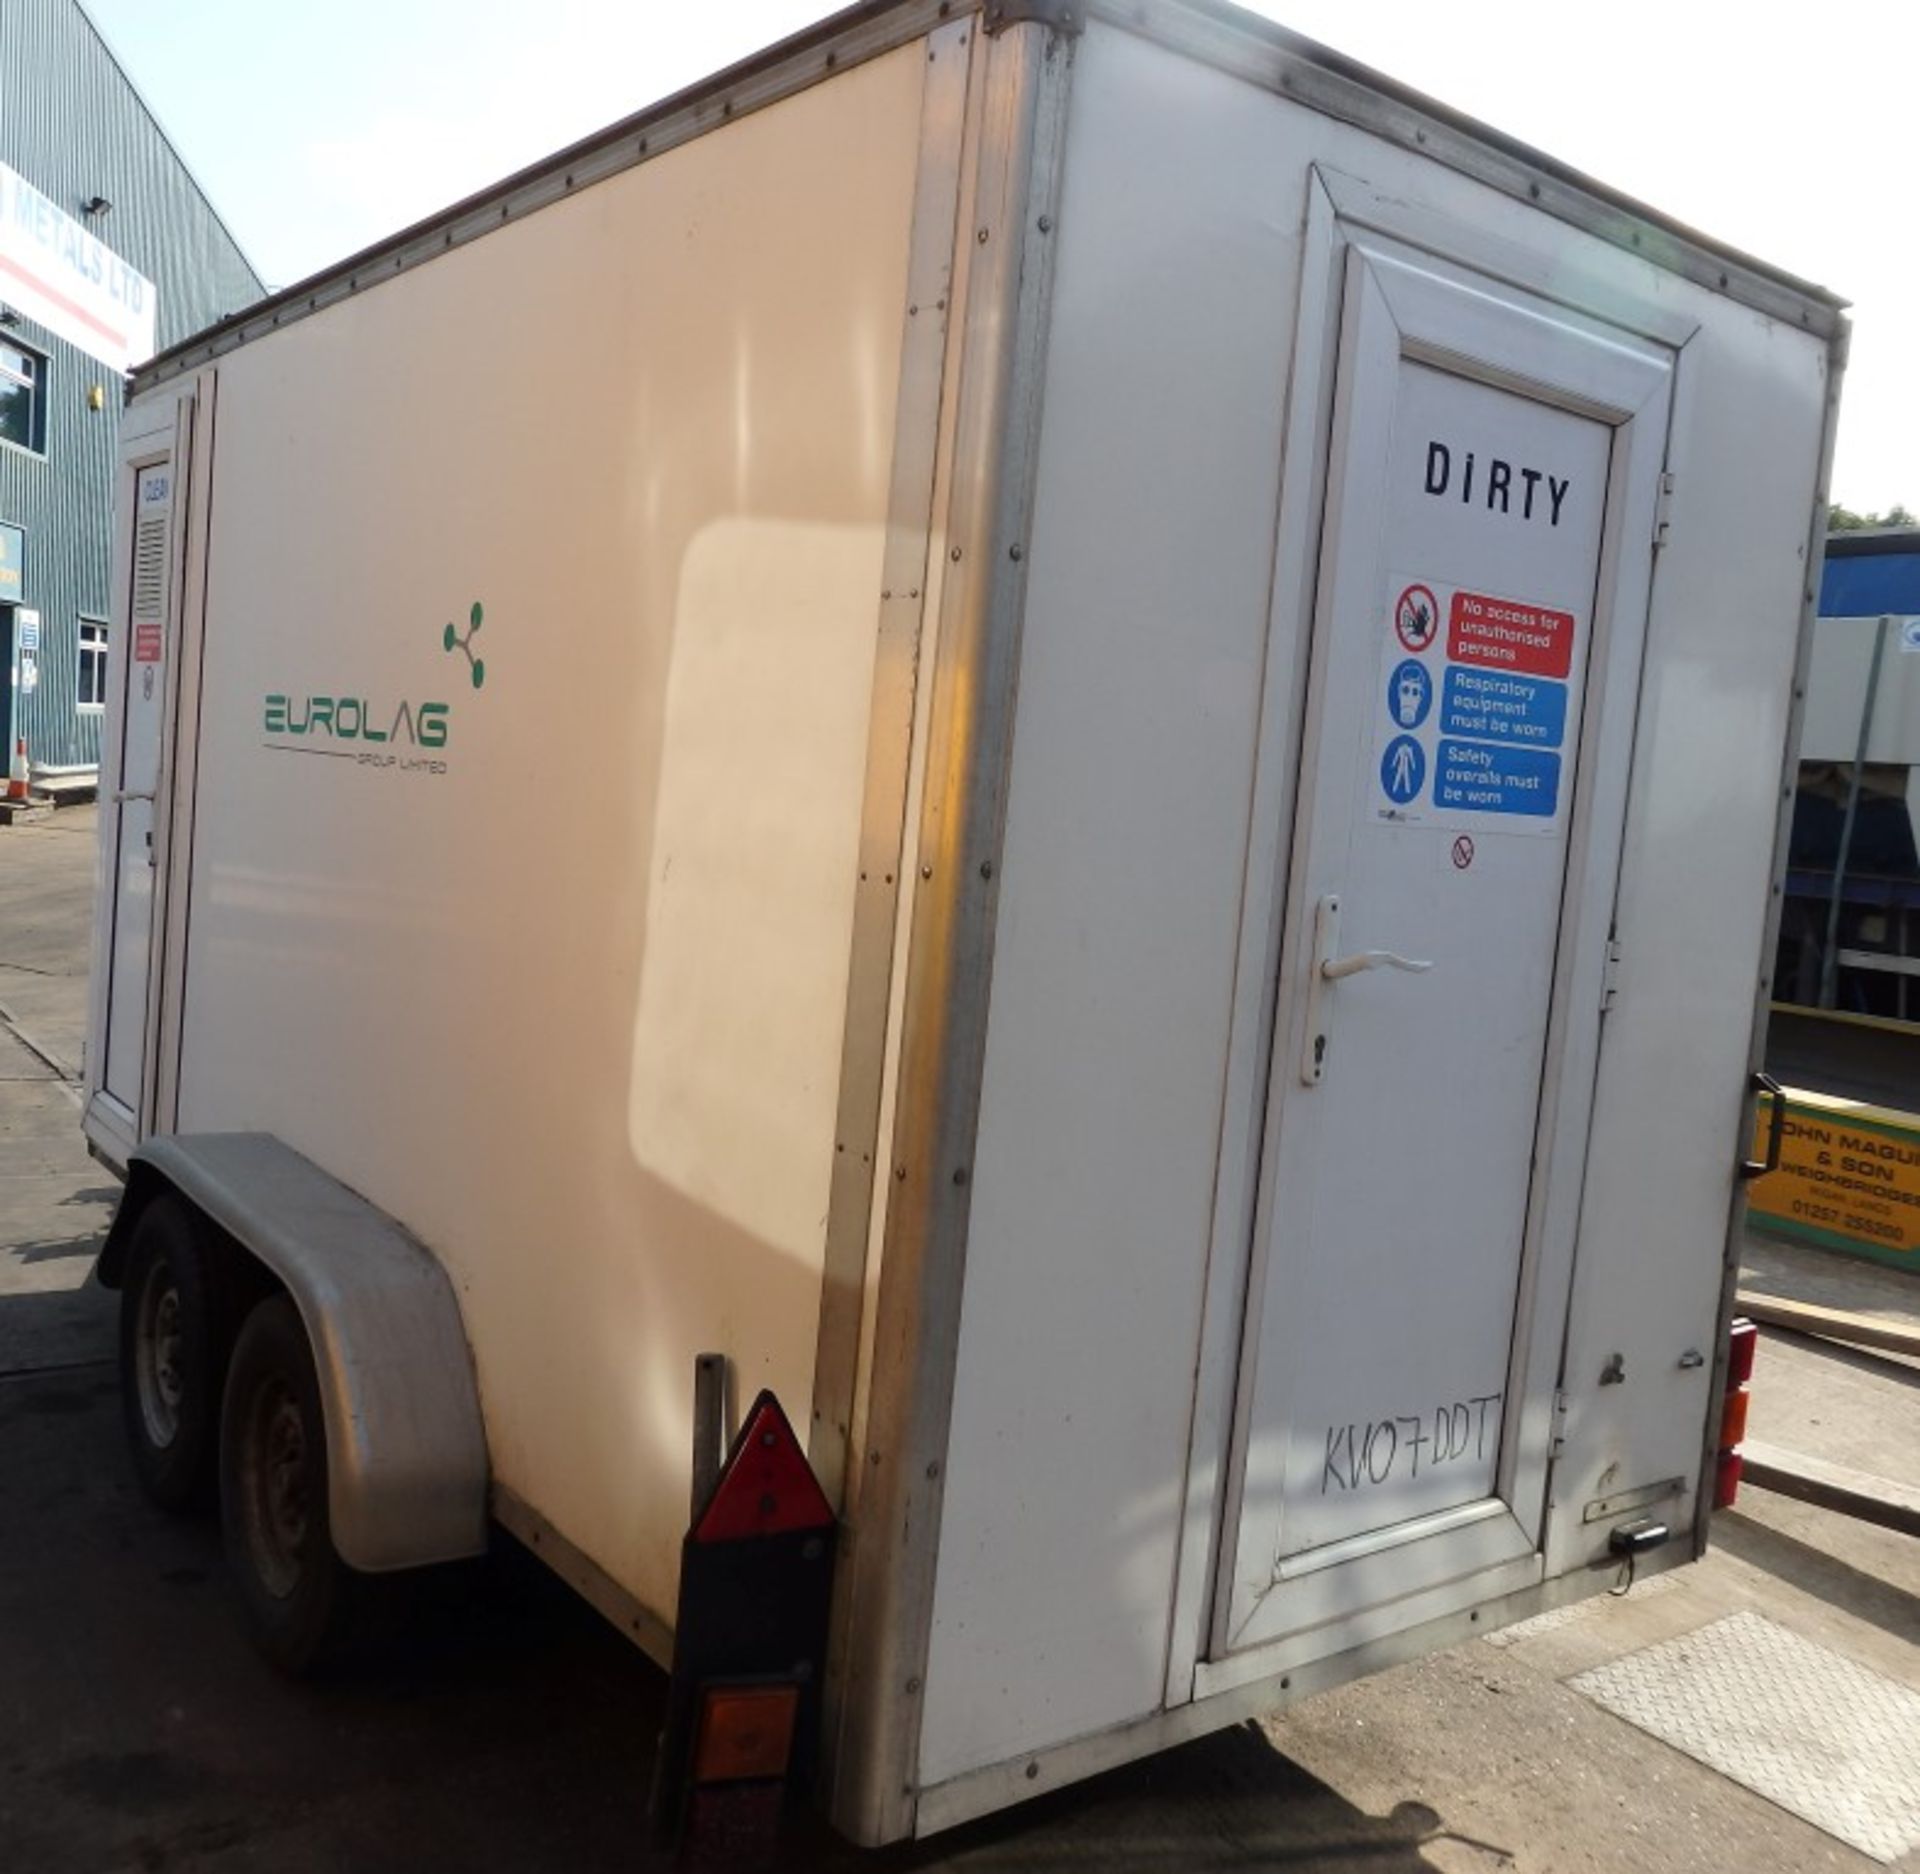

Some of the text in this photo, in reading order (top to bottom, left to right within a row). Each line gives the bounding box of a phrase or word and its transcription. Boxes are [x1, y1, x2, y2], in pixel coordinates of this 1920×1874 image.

[14, 178, 103, 285] METALS
[109, 256, 143, 314] LTD
[1462, 600, 1559, 630] No access for
[1460, 621, 1551, 648] unauthorised
[1458, 641, 1516, 661] persons
[1455, 673, 1536, 701] Respiratory
[1453, 695, 1527, 716] equipment
[264, 695, 449, 748] EUROLAG
[1451, 715, 1548, 738] must be worn
[356, 753, 448, 775] GROUP LIMITED
[1448, 747, 1493, 768] Safety
[1504, 775, 1540, 789] must
[1443, 786, 1503, 804] be worn
[1768, 1122, 1831, 1145] OHN
[1816, 1151, 1894, 1181] & SON
